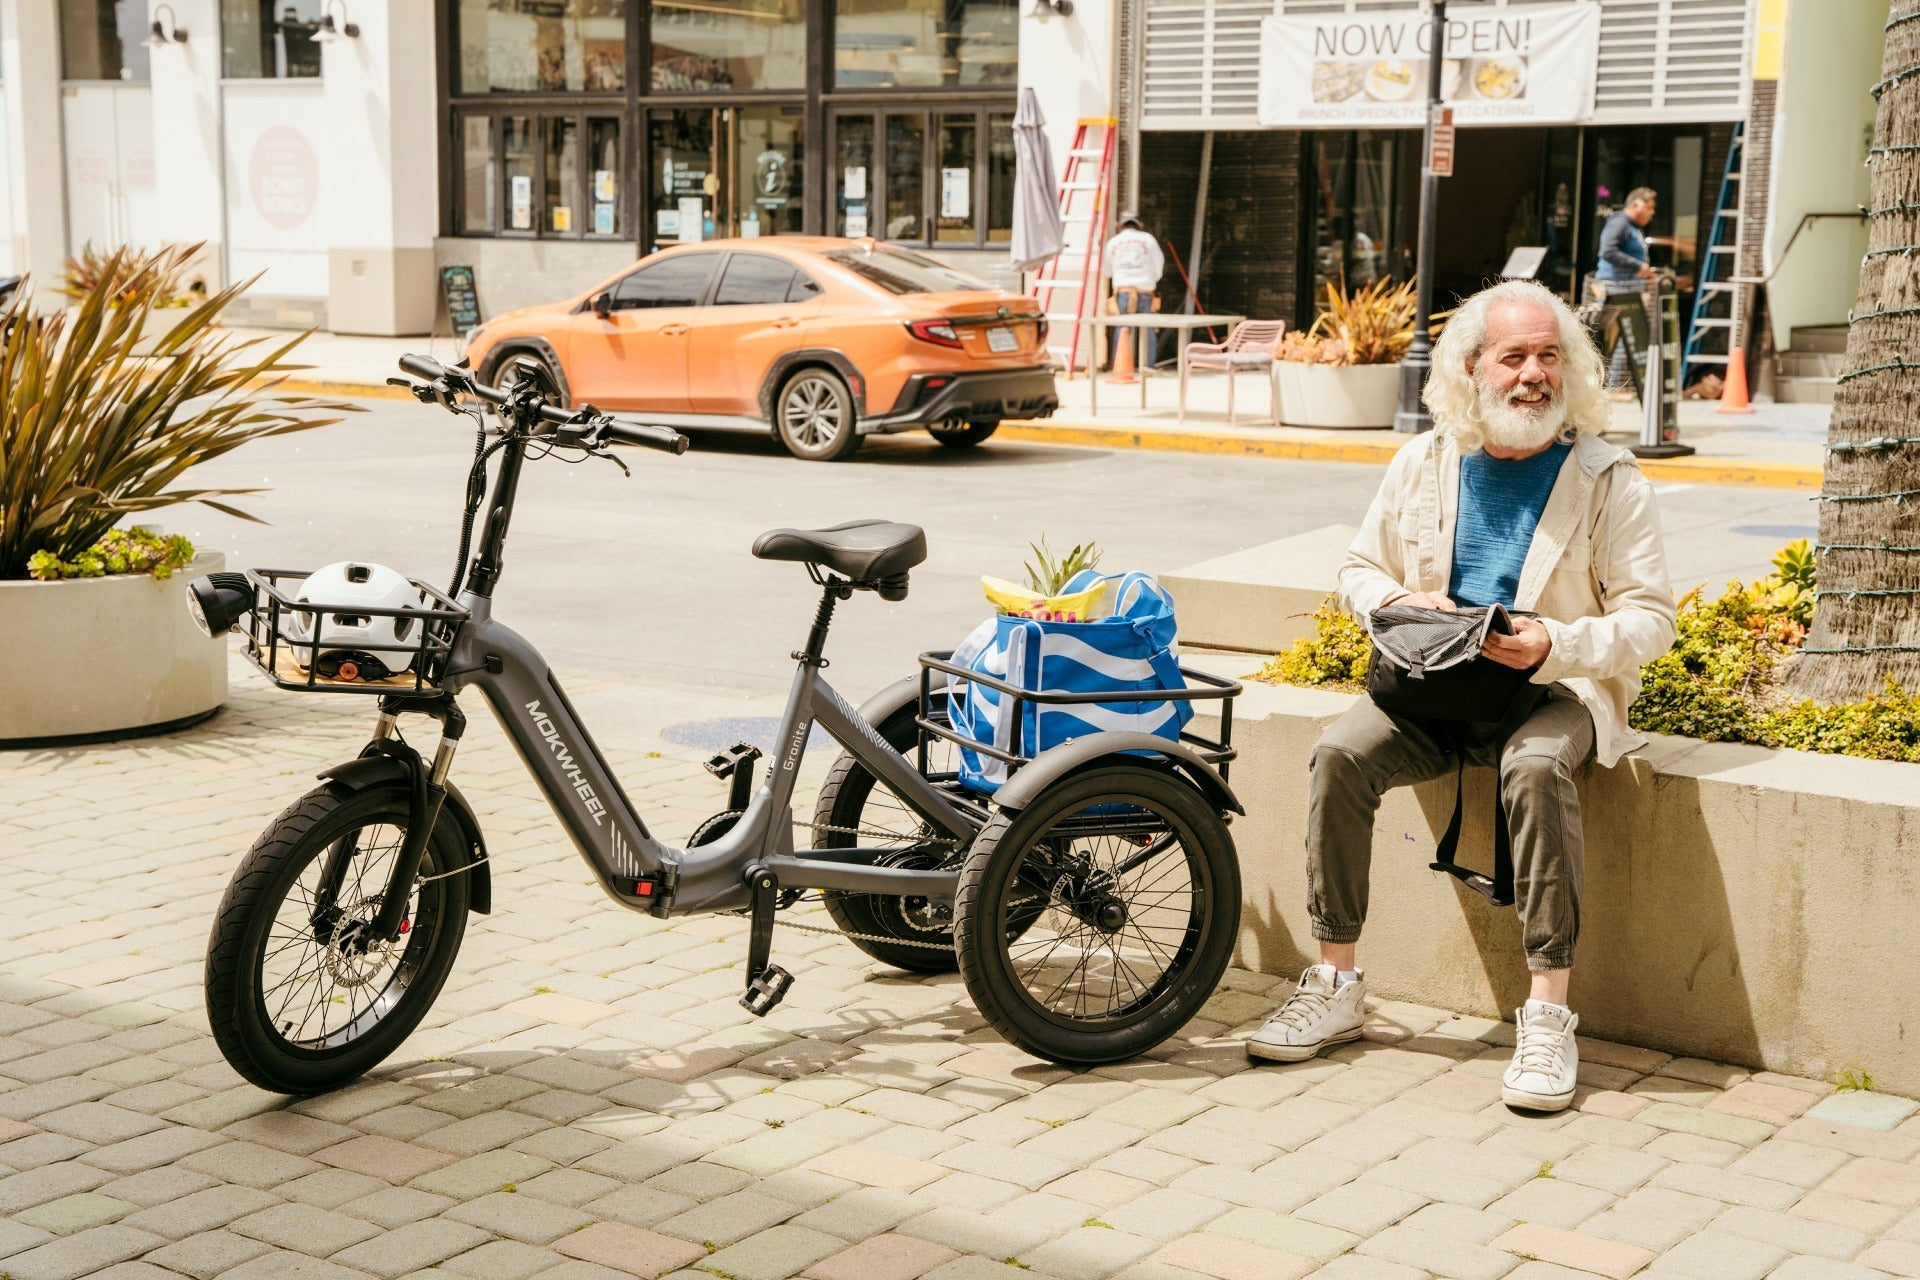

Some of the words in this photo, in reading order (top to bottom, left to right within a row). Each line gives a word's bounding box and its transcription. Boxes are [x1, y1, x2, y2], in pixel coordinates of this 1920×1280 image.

[1314, 23, 1406, 56] NOW
[1298, 105, 1347, 120] BRUNCH
[1354, 104, 1416, 120] SPECIALTY
[1473, 103, 1535, 118] CATERING
[525, 699, 607, 827] MOKWHEEL
[782, 721, 807, 771] Granite
